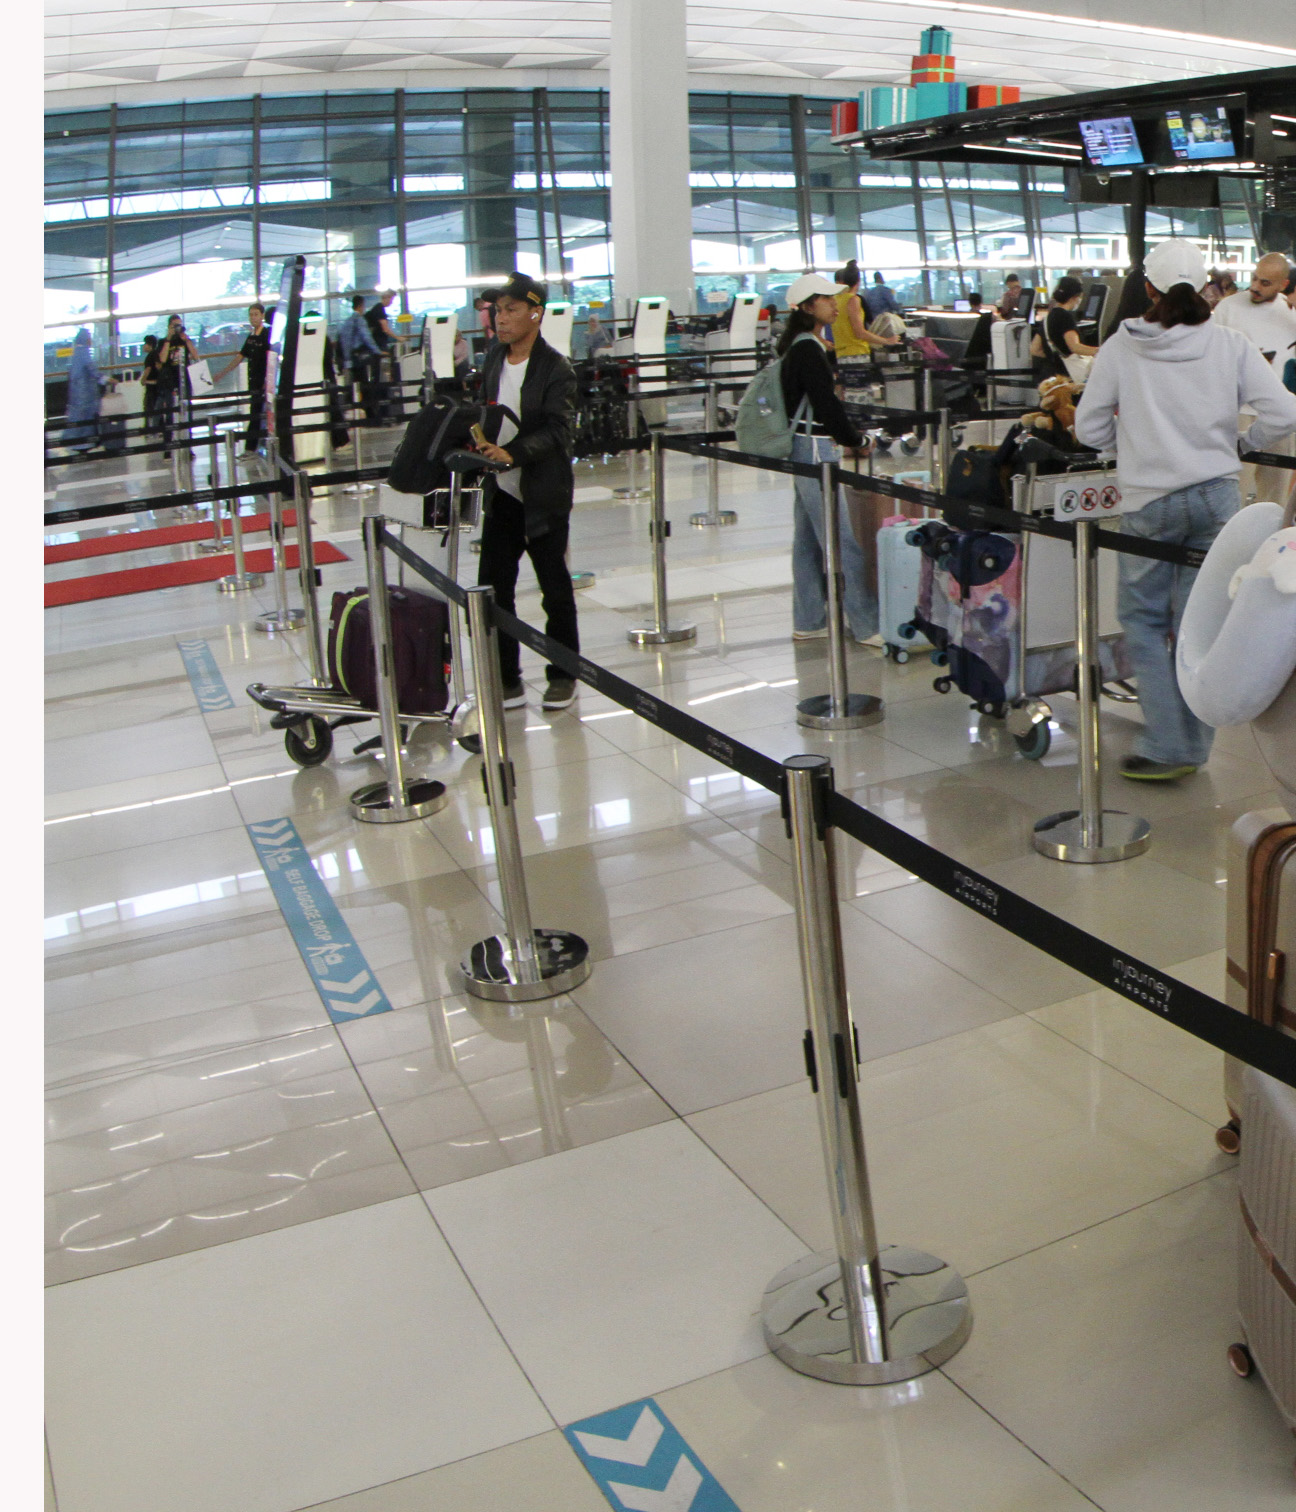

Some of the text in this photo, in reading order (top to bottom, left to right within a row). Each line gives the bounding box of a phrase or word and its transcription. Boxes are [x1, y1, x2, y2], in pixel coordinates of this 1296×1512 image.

[292, 885, 322, 921] BAGGAGE
[308, 919, 333, 941] DROP
[1112, 957, 1173, 1003] injourney
[1113, 977, 1169, 1012] AIRPORTS
